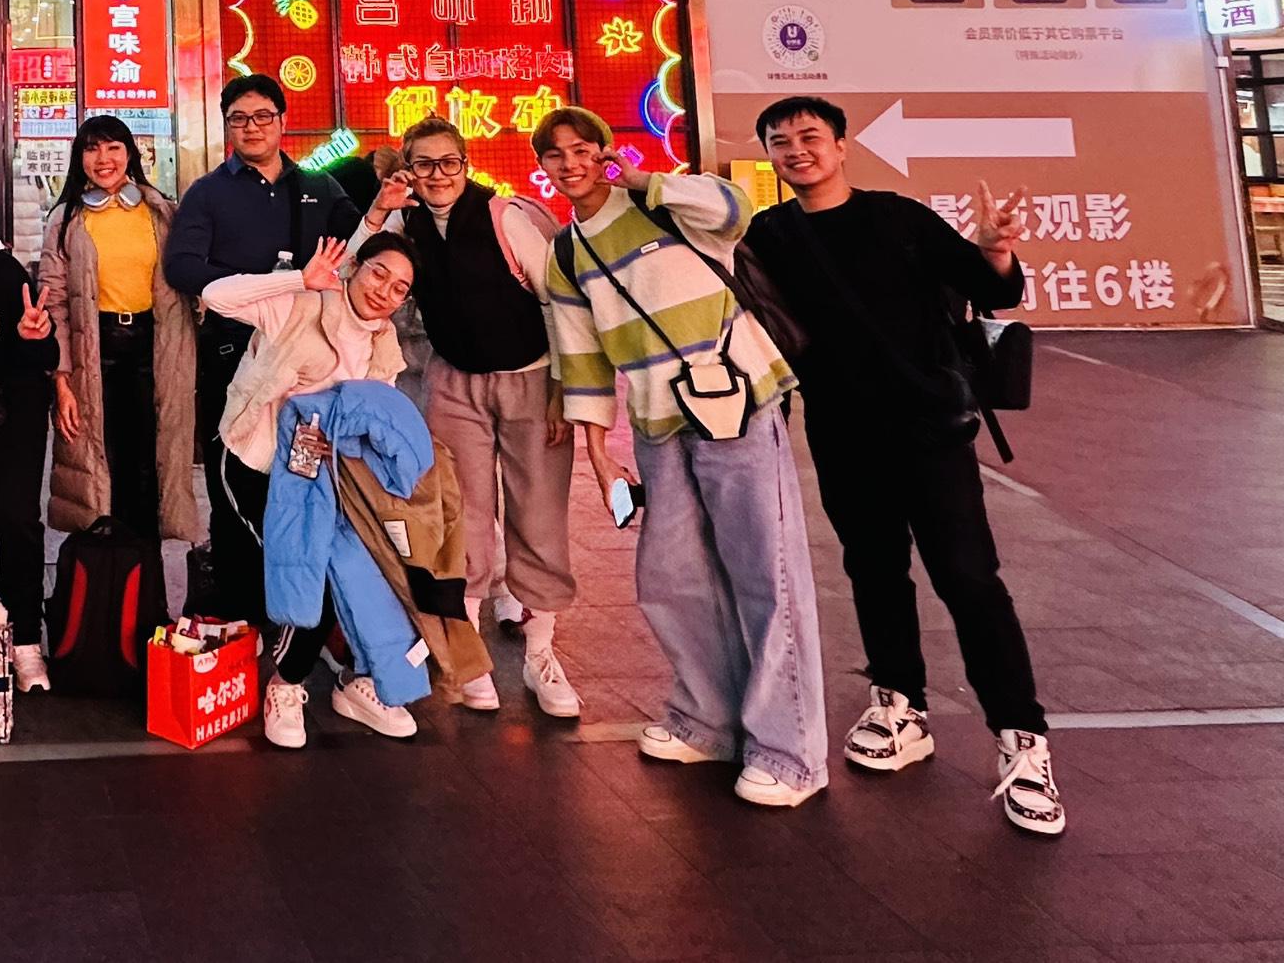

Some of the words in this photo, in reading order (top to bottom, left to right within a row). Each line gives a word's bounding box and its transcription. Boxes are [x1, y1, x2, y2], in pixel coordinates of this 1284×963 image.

[108, 4, 142, 84] 宫味渝
[340, 43, 574, 82] 韩式自助烤肉
[26, 150, 64, 161] 临时工
[27, 162, 65, 173] 寒假工
